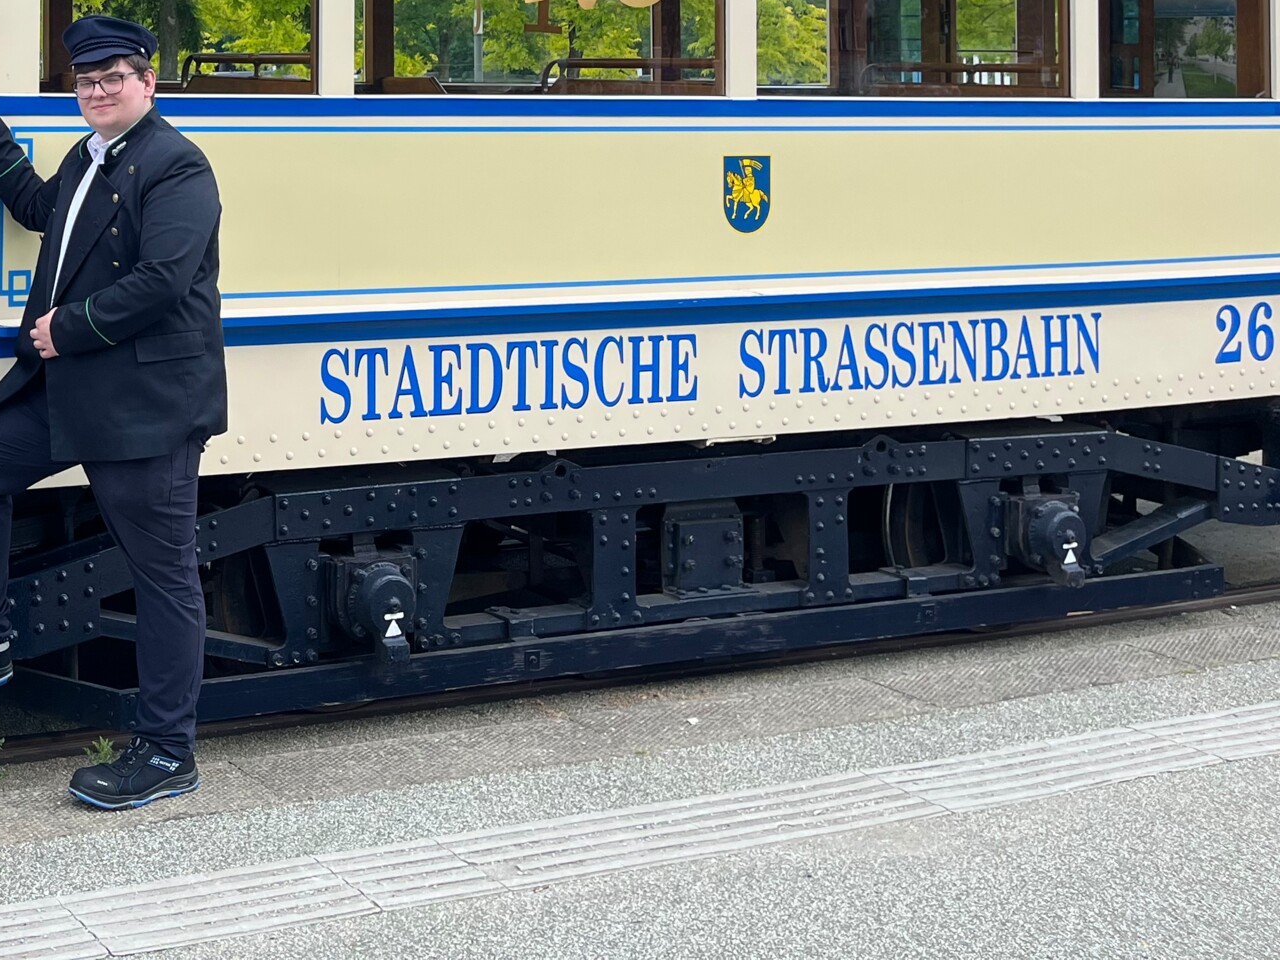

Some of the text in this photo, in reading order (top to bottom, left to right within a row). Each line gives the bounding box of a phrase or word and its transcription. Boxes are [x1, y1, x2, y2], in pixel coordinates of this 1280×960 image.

[319, 301, 1275, 425] STAEDTISCHE STRASSENBAHN 26
